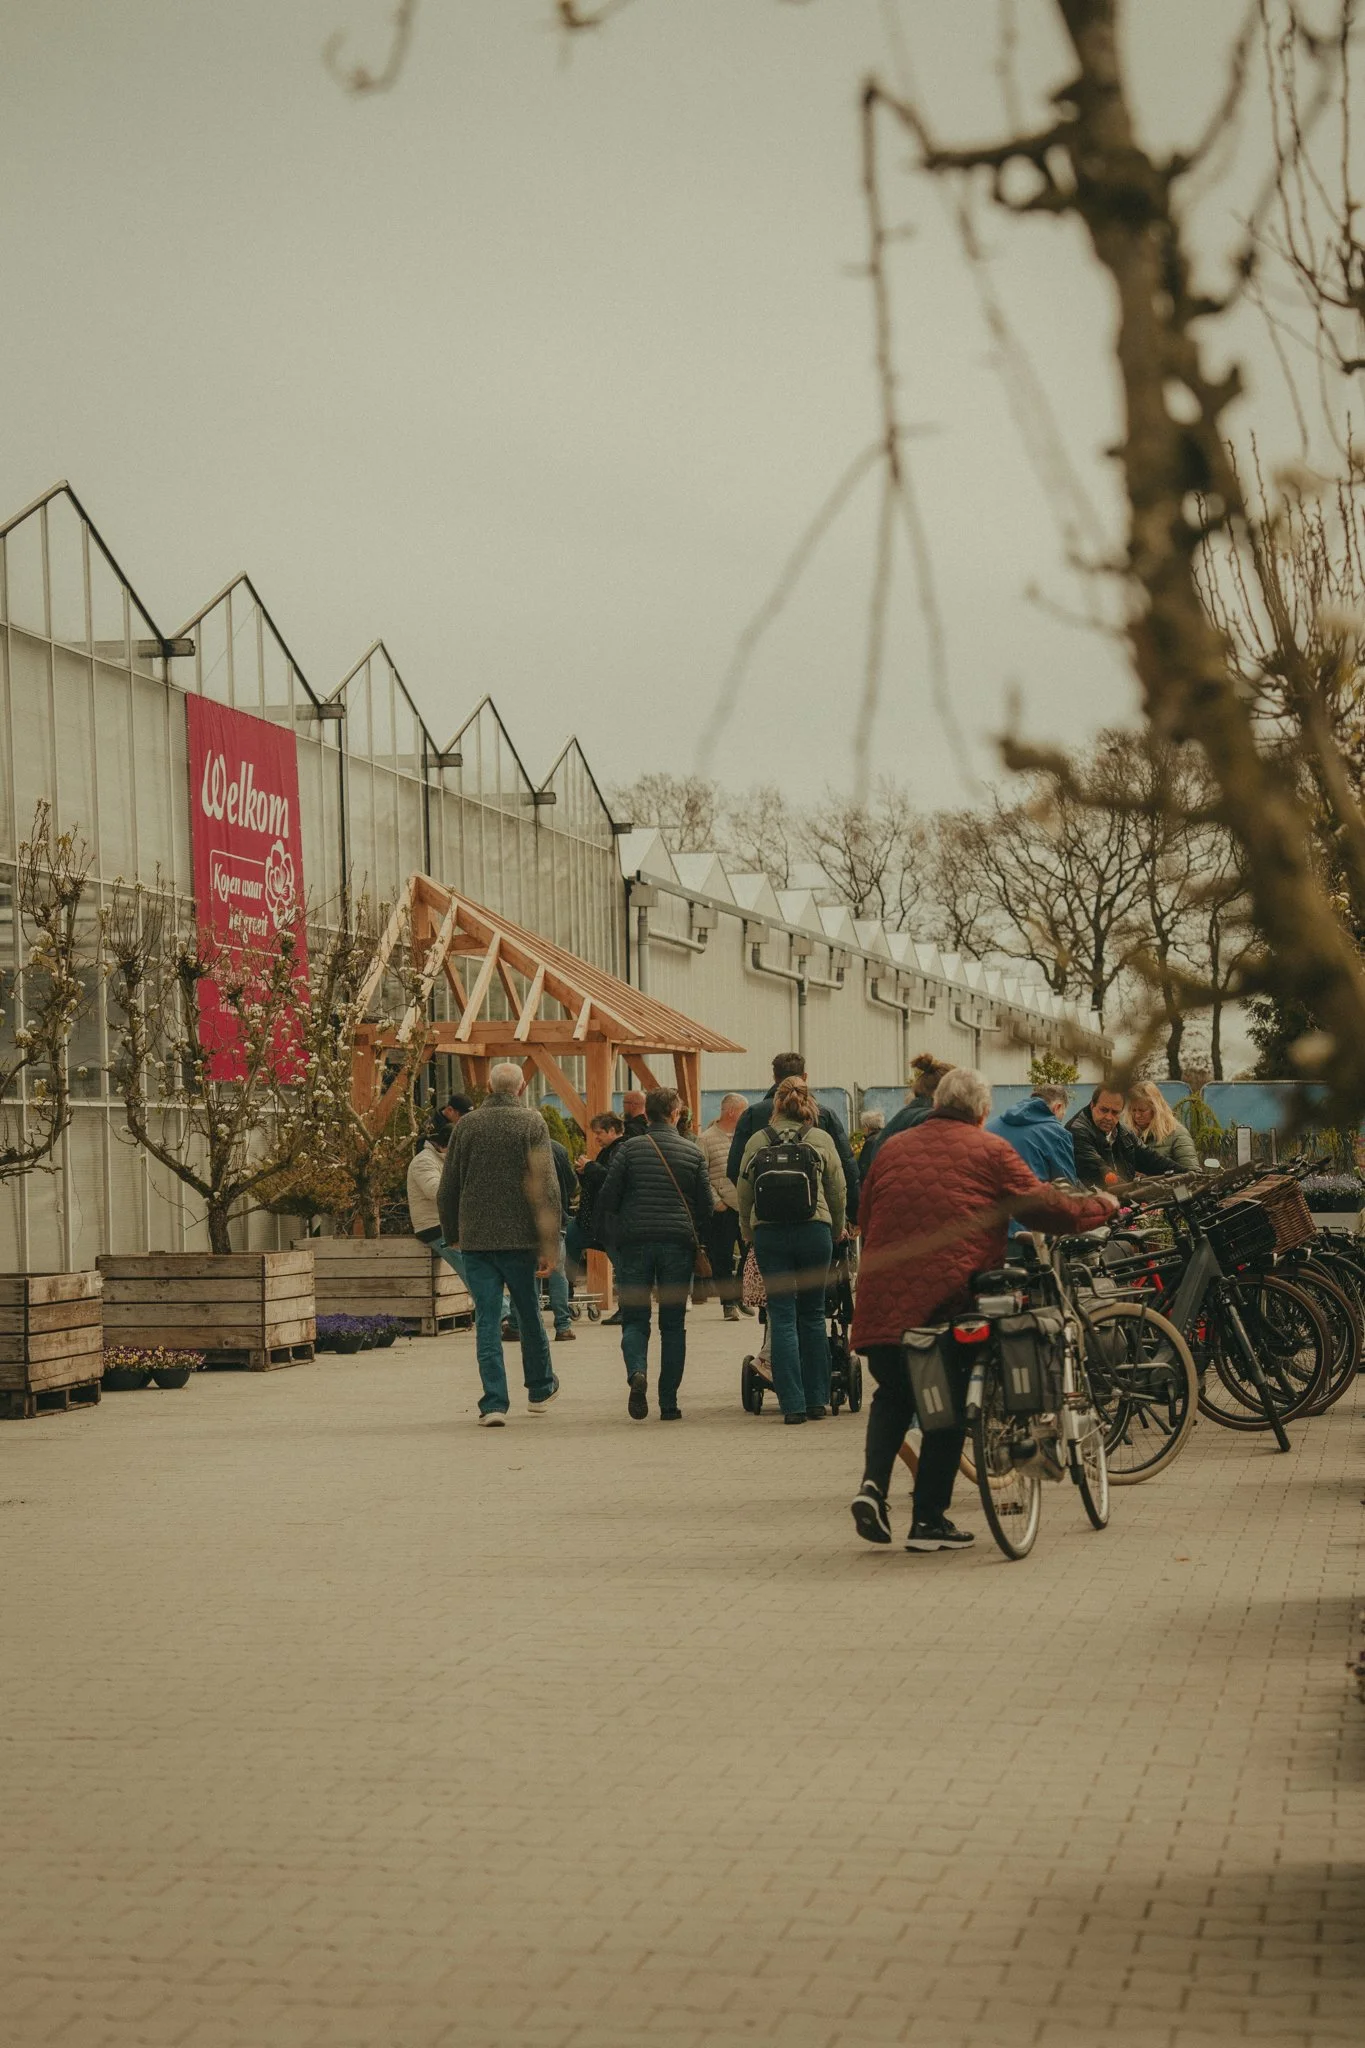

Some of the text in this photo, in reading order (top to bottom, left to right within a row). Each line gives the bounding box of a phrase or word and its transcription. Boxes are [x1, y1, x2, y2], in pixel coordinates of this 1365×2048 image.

[202, 749, 289, 838] Welkom
[214, 863, 263, 903] Kopen waar
[243, 911, 268, 944] groeit
